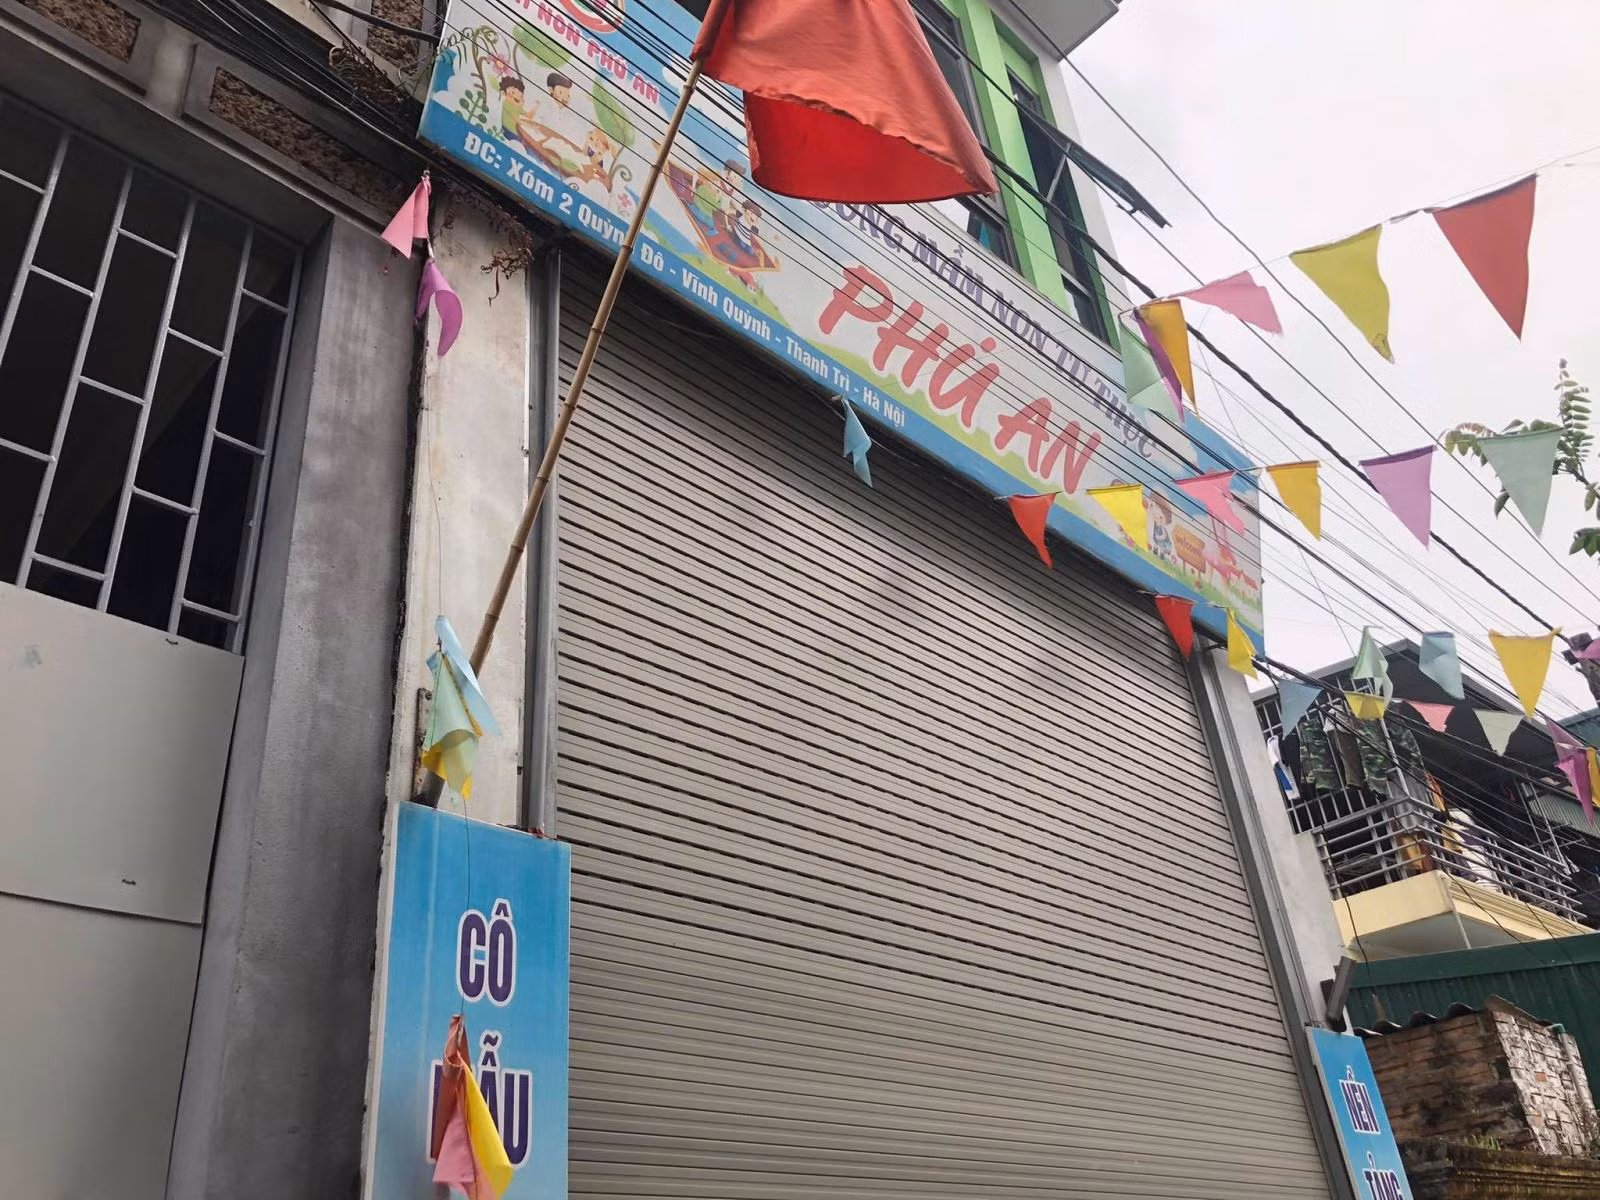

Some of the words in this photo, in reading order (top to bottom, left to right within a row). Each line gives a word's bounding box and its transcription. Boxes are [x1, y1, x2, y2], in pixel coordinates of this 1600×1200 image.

[538, 2, 580, 47] NON
[632, 74, 660, 105] AN
[463, 131, 503, 169] ĐC:
[506, 157, 555, 203] Xóm
[558, 192, 574, 215] 2
[577, 203, 635, 254] Quỳn
[640, 242, 665, 272] Đô
[682, 267, 719, 307] Vĩnh
[722, 296, 771, 341] Quỳnh
[786, 335, 829, 379] Thanh
[863, 386, 881, 412] Hà
[883, 399, 906, 428] Nội
[991, 289, 1050, 352] NON
[818, 264, 1000, 428] PHÚ
[994, 397, 1102, 495] AN
[458, 899, 515, 1005] CÔ
